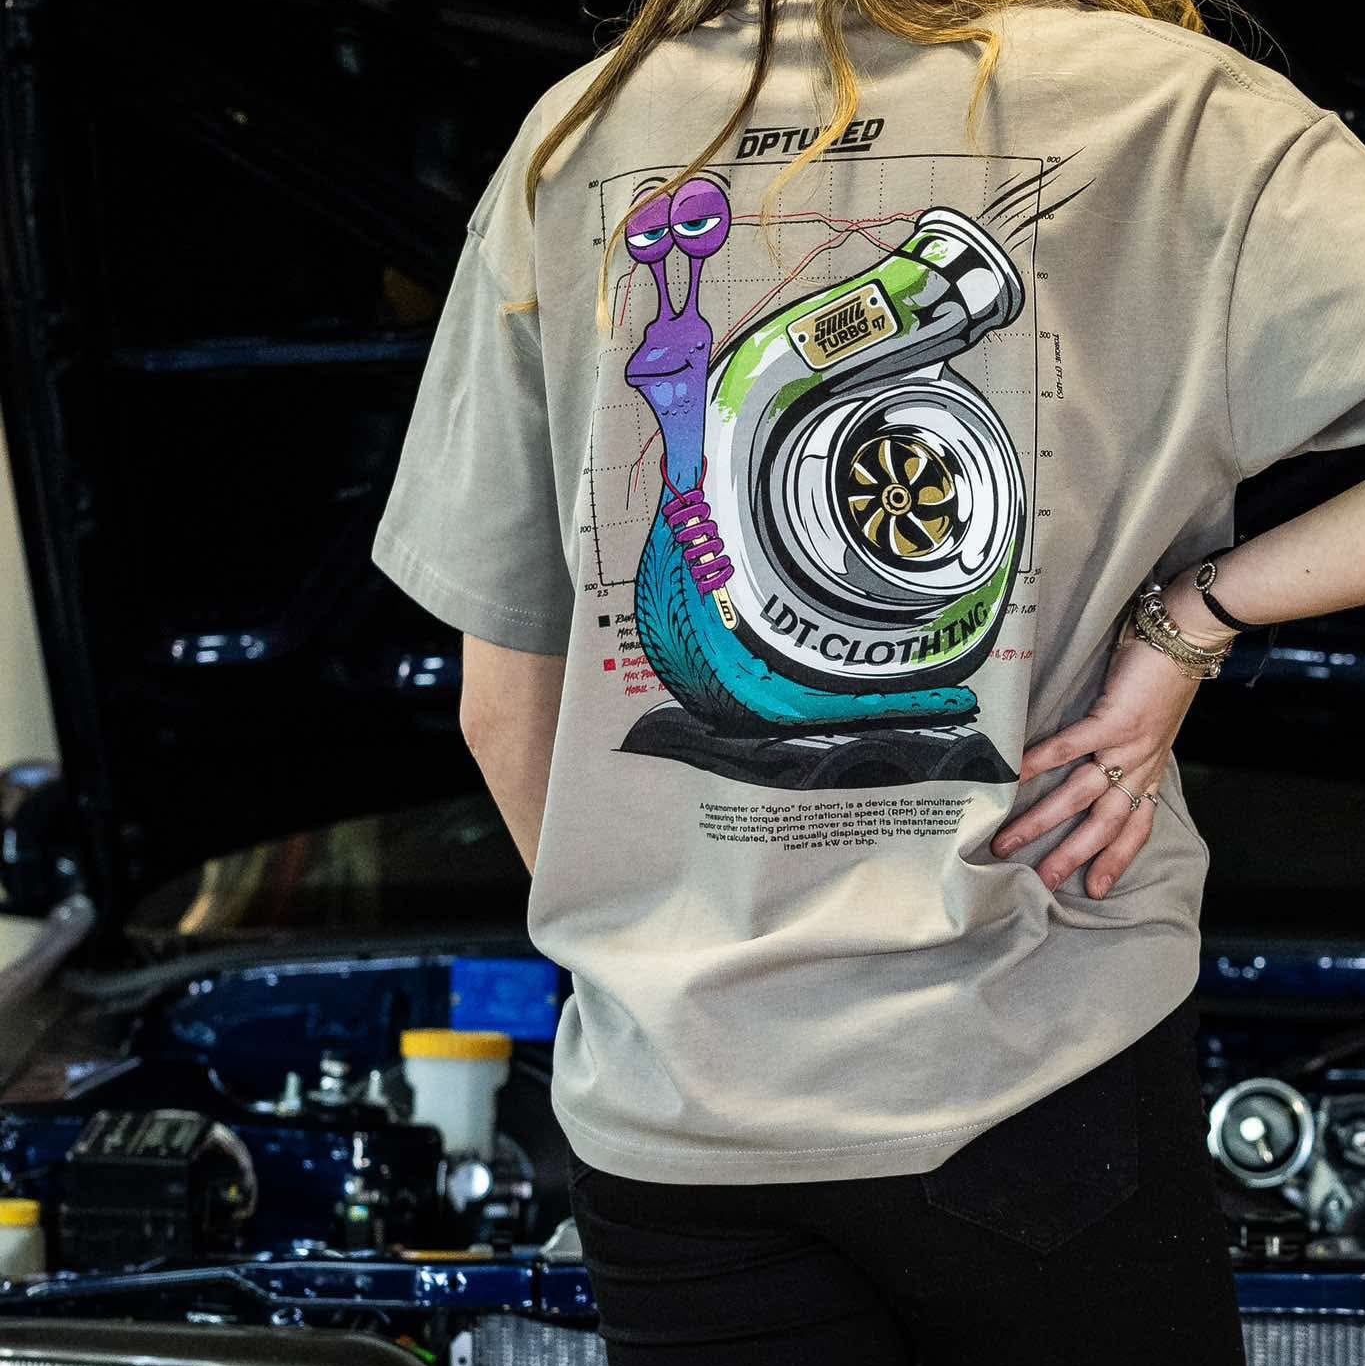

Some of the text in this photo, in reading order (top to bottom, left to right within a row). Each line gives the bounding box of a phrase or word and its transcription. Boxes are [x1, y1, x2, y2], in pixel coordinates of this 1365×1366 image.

[814, 301, 865, 343] SNAIL
[817, 317, 869, 354] TURBO
[760, 594, 989, 667] LDT.CLOTHING
[814, 803, 843, 811] short,
[750, 815, 780, 823] torque
[783, 814, 801, 822] and
[804, 811, 852, 821] rotational
[854, 809, 885, 818] speed
[887, 808, 917, 817] (RPM)
[727, 835, 768, 843] calculated,
[770, 833, 790, 841] and
[792, 830, 828, 839] usually
[830, 828, 879, 838] displayed
[881, 828, 894, 836] by
[740, 825, 774, 834] rotating
[776, 824, 806, 833] prime
[783, 843, 808, 851] itself
[855, 838, 878, 846] bhp.
